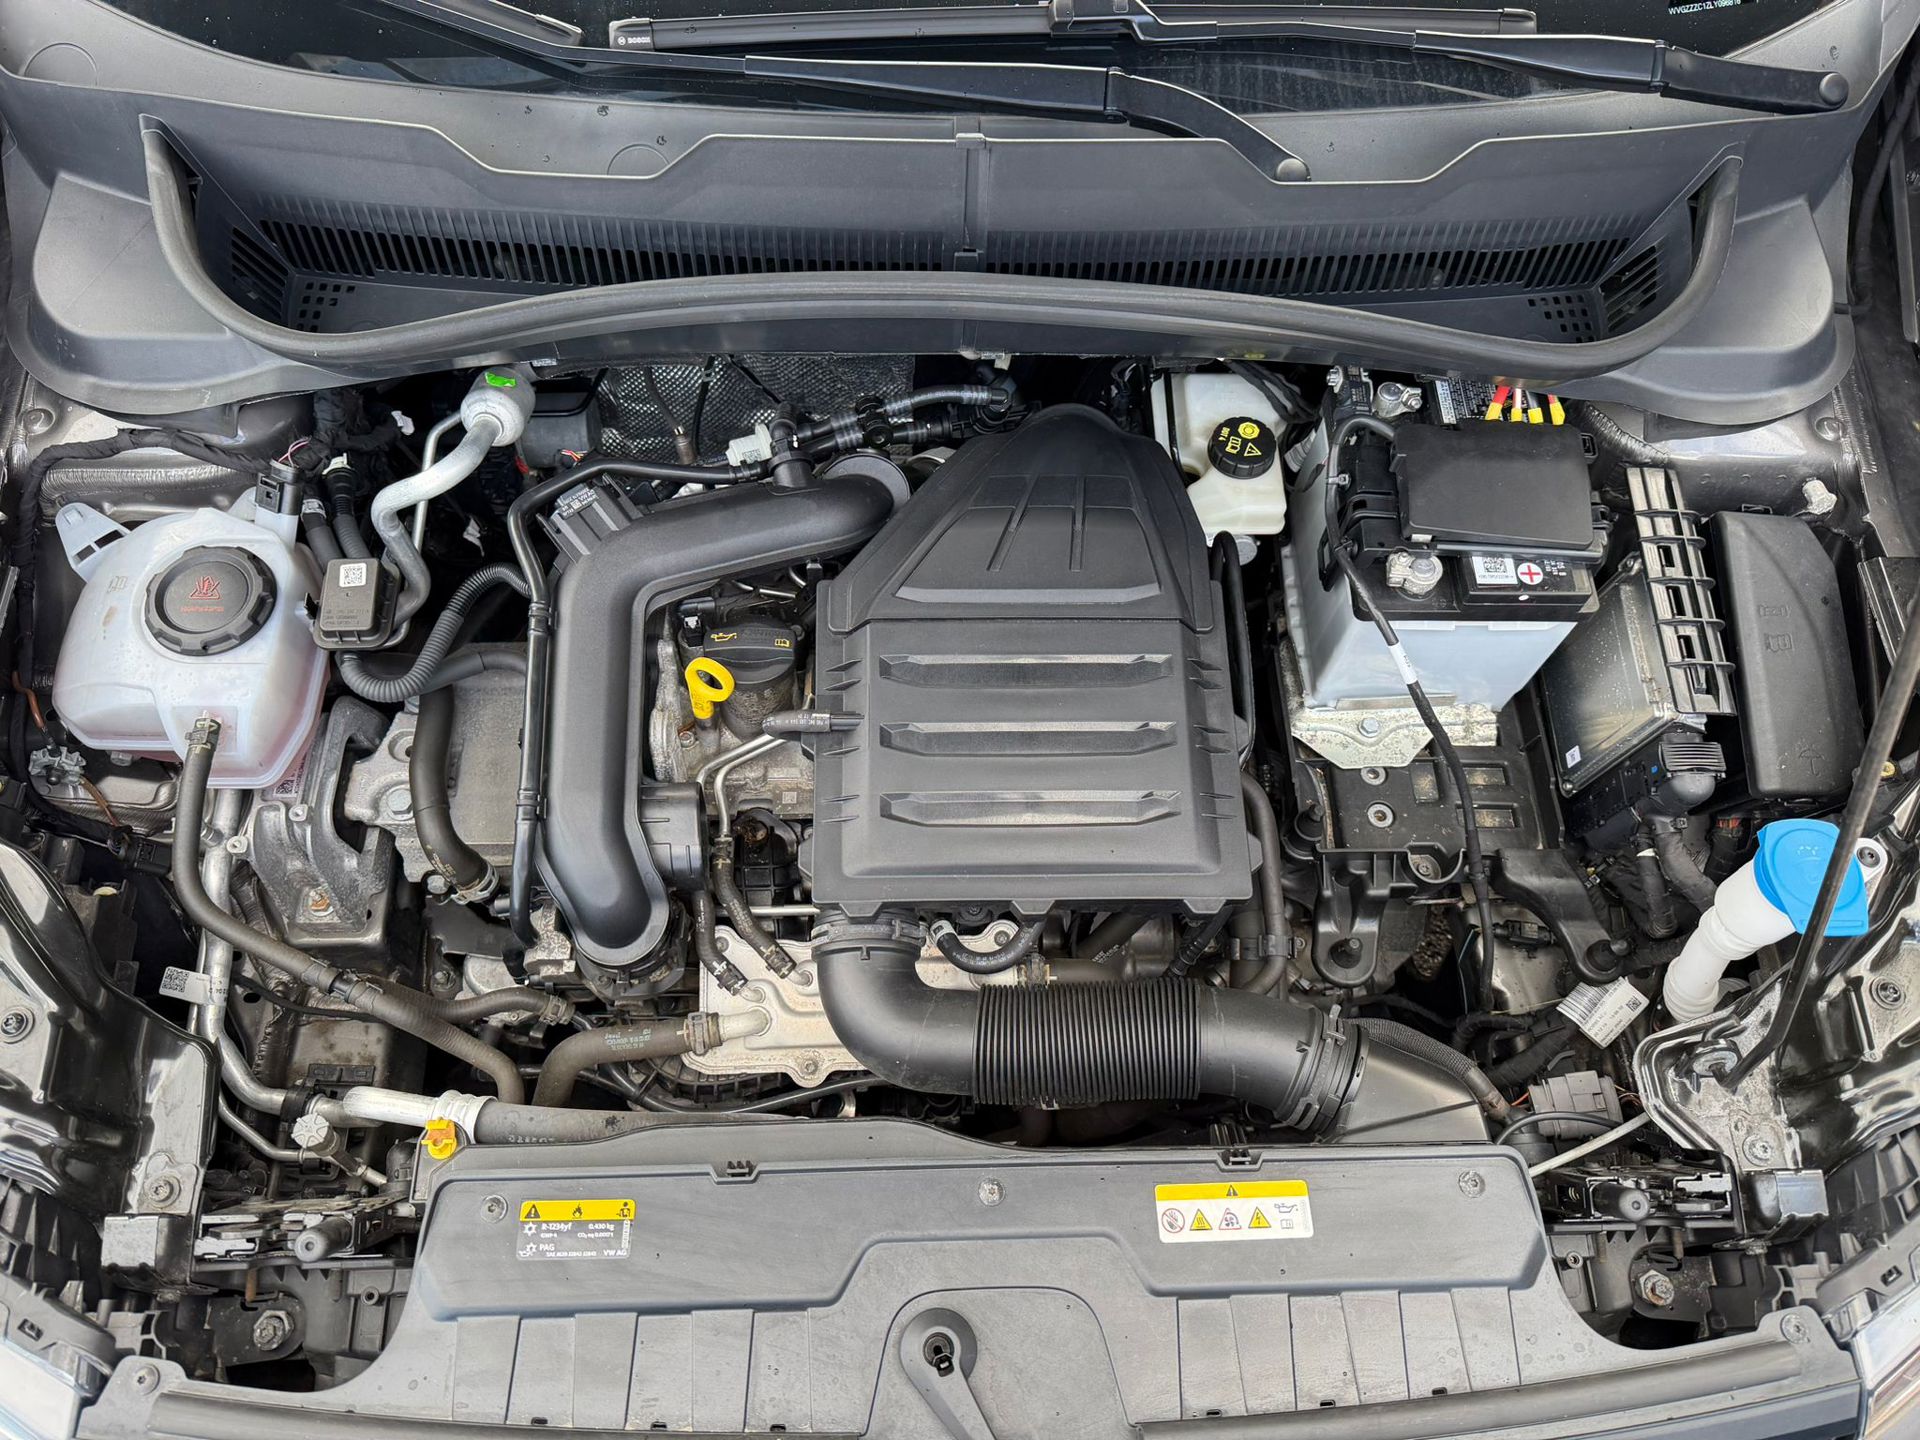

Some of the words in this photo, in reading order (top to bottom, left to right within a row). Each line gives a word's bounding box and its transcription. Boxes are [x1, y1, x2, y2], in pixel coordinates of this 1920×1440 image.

[541, 1222, 572, 1232] R-1234yf
[606, 1223, 615, 1231] kg
[539, 1243, 554, 1251] PAG
